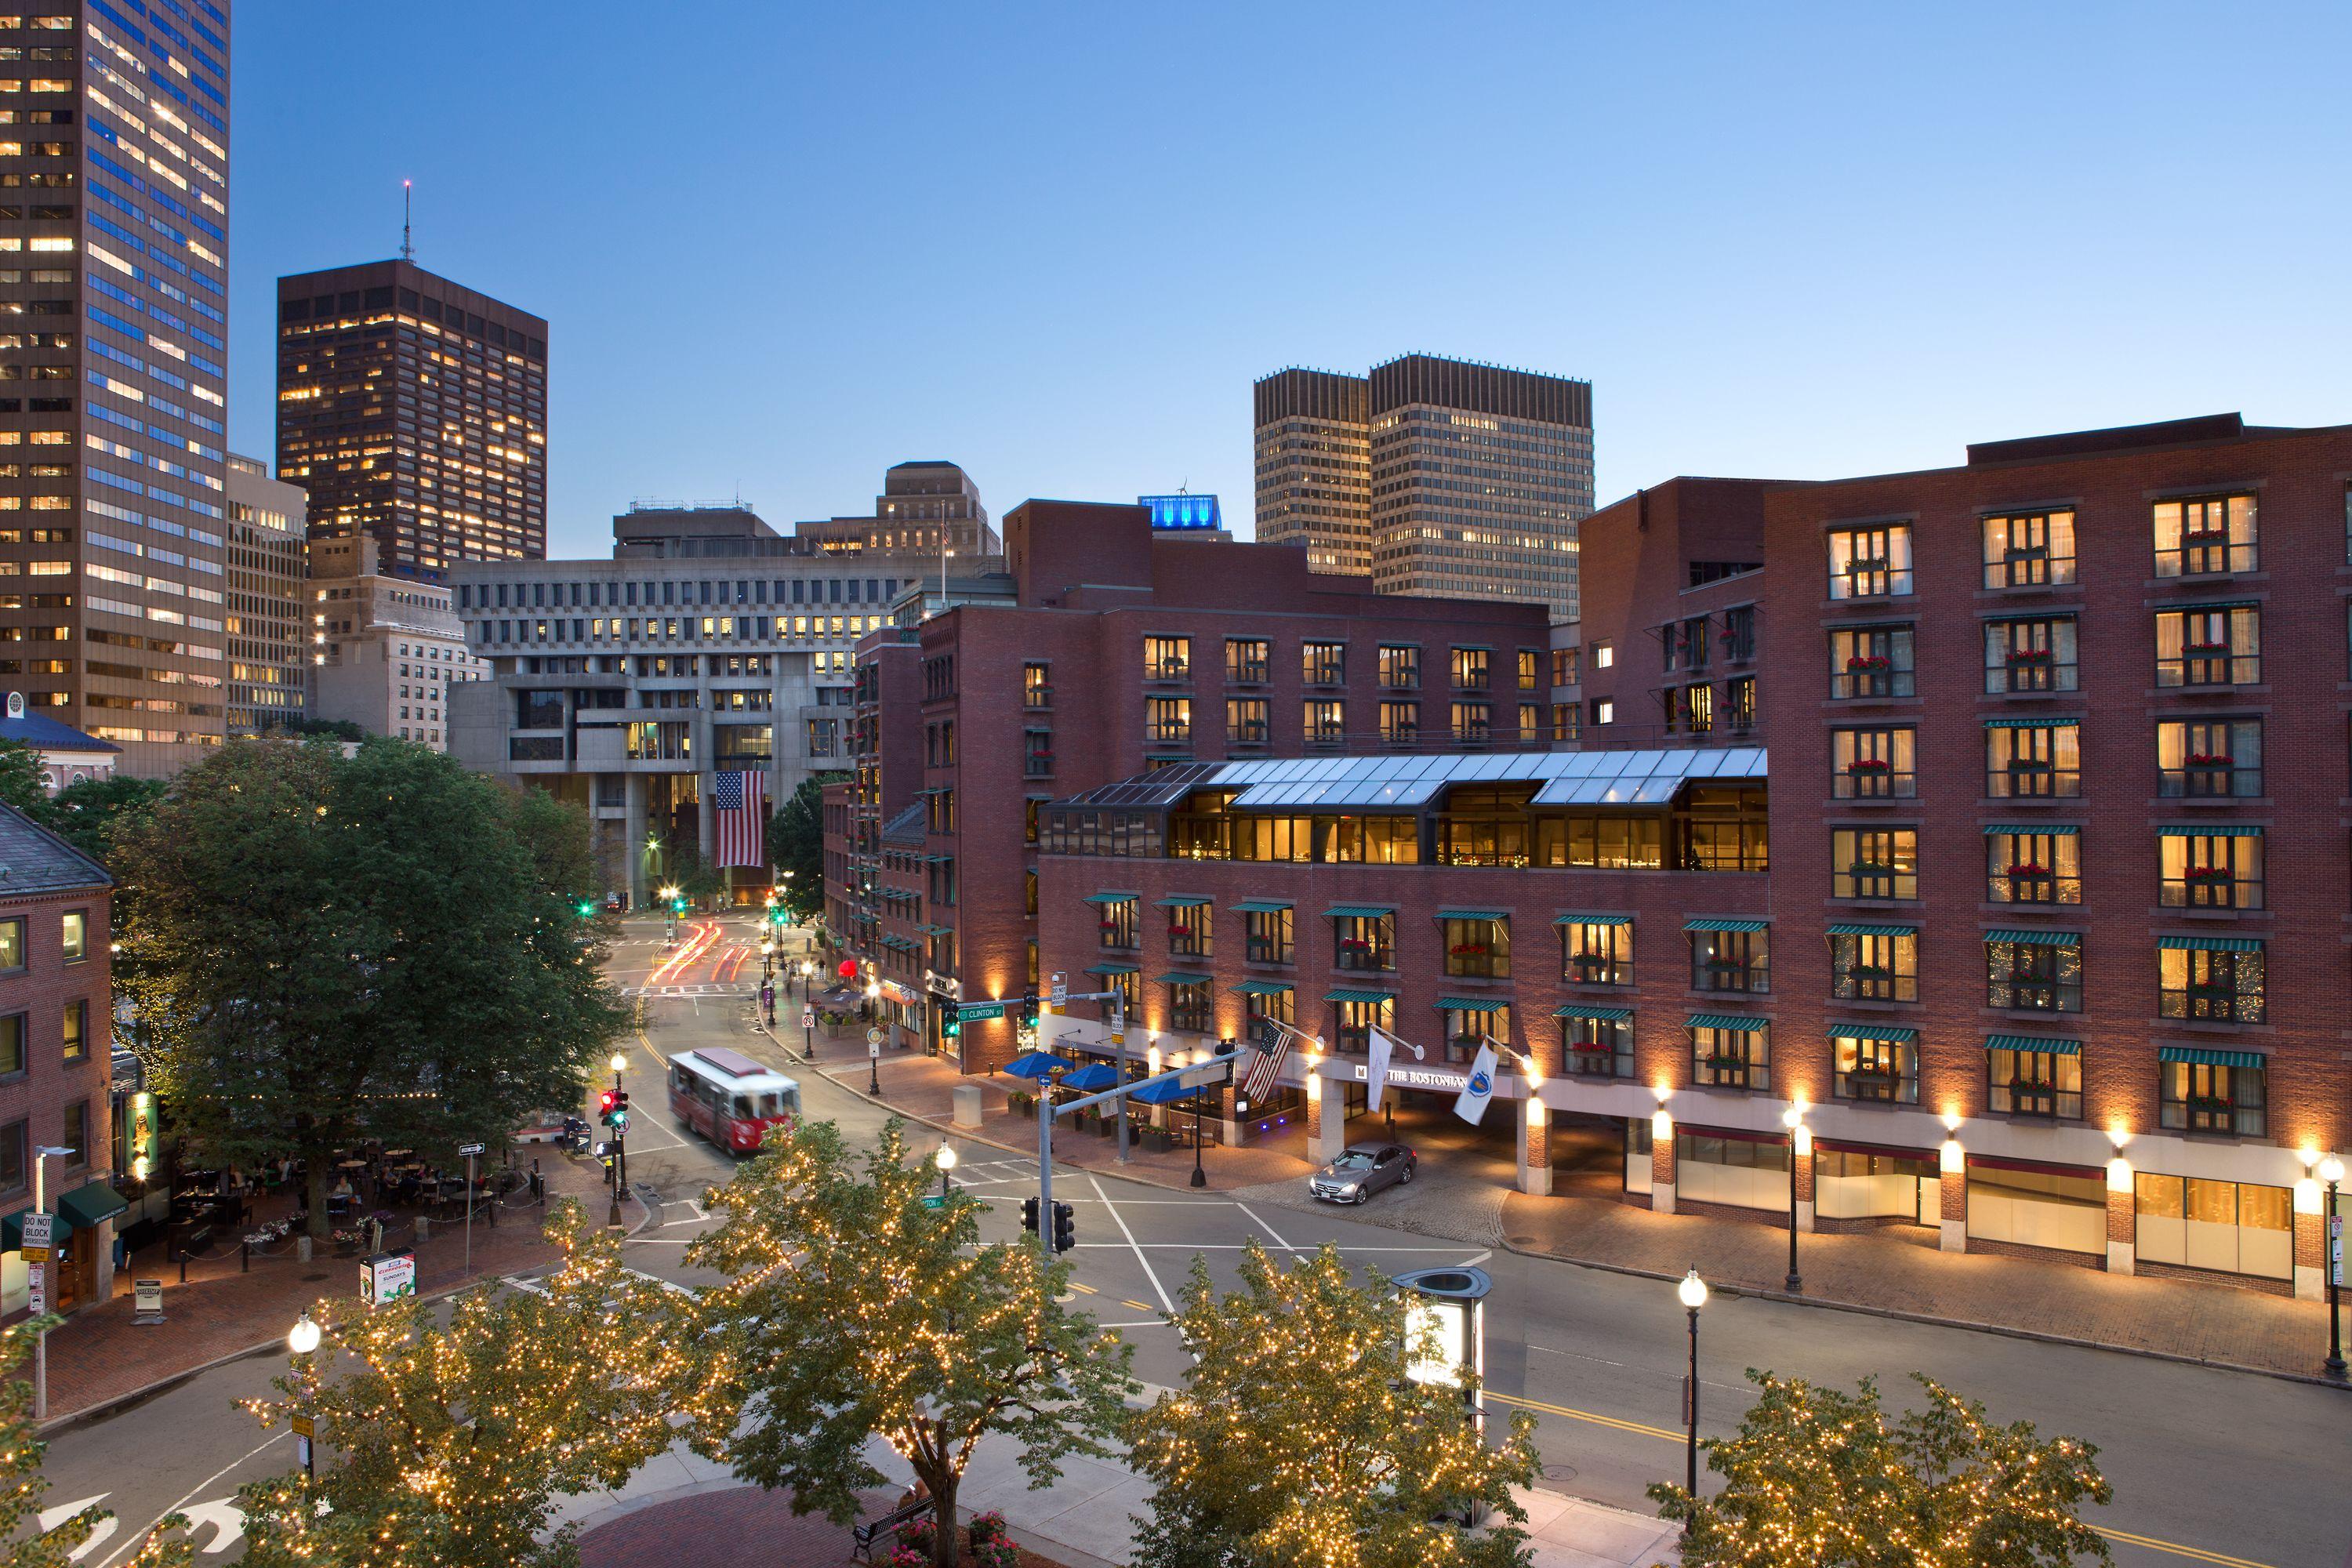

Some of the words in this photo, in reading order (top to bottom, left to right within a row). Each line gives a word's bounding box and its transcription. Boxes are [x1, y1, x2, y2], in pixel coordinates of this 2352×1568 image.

[969, 1009, 994, 1018] CLINTON
[1388, 1069, 1407, 1082] THE
[1409, 1072, 1468, 1088] BOSTONIAN
[25, 1217, 34, 1225] DO
[26, 1228, 49, 1237] BLOCK
[383, 1271, 405, 1281] SUNDAYS
